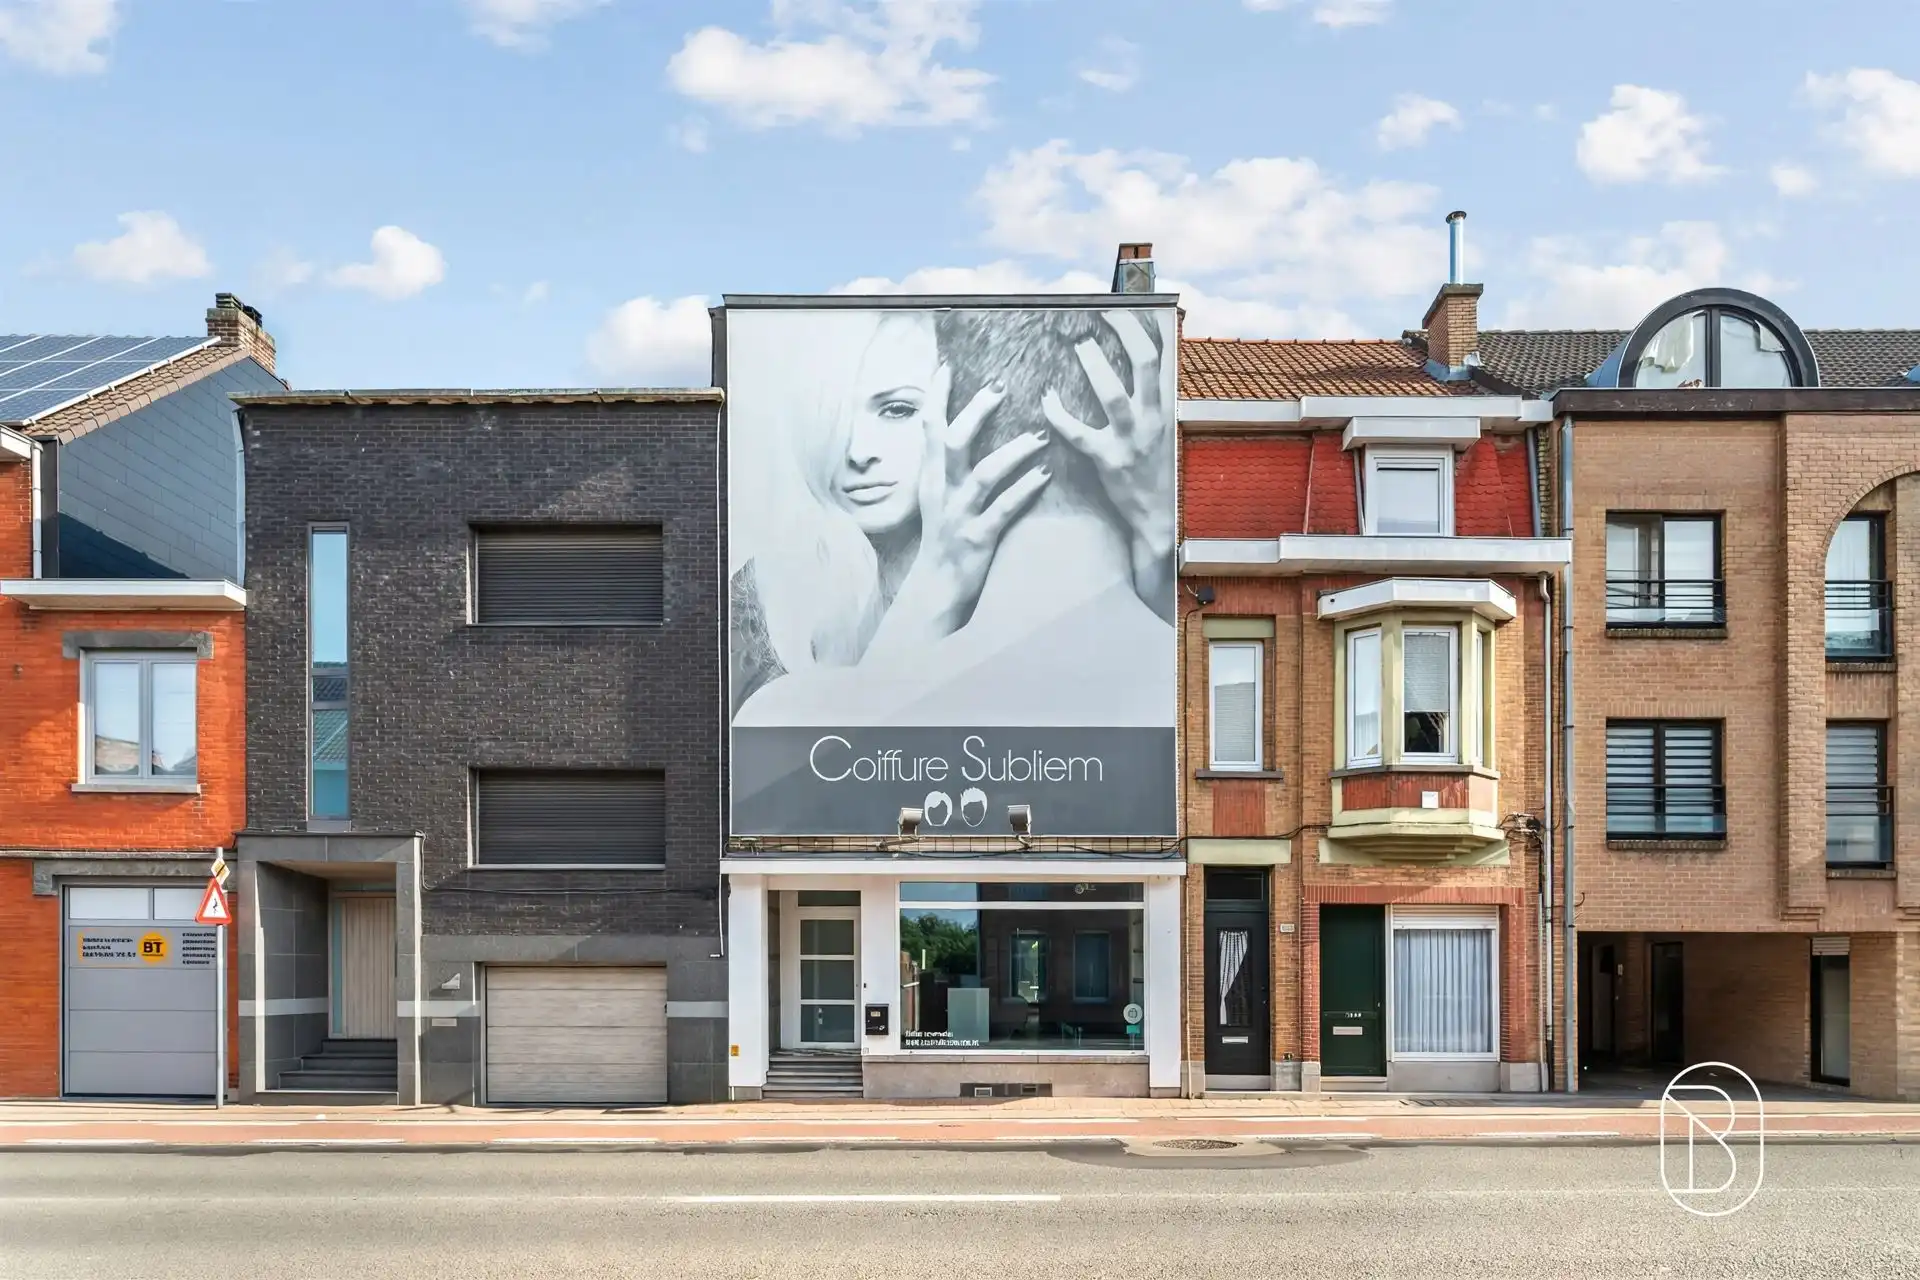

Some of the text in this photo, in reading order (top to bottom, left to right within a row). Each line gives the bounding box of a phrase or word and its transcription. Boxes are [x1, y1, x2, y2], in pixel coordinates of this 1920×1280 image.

[809, 735, 1103, 782] Coiffure Subliem
[143, 941, 164, 953] BT
